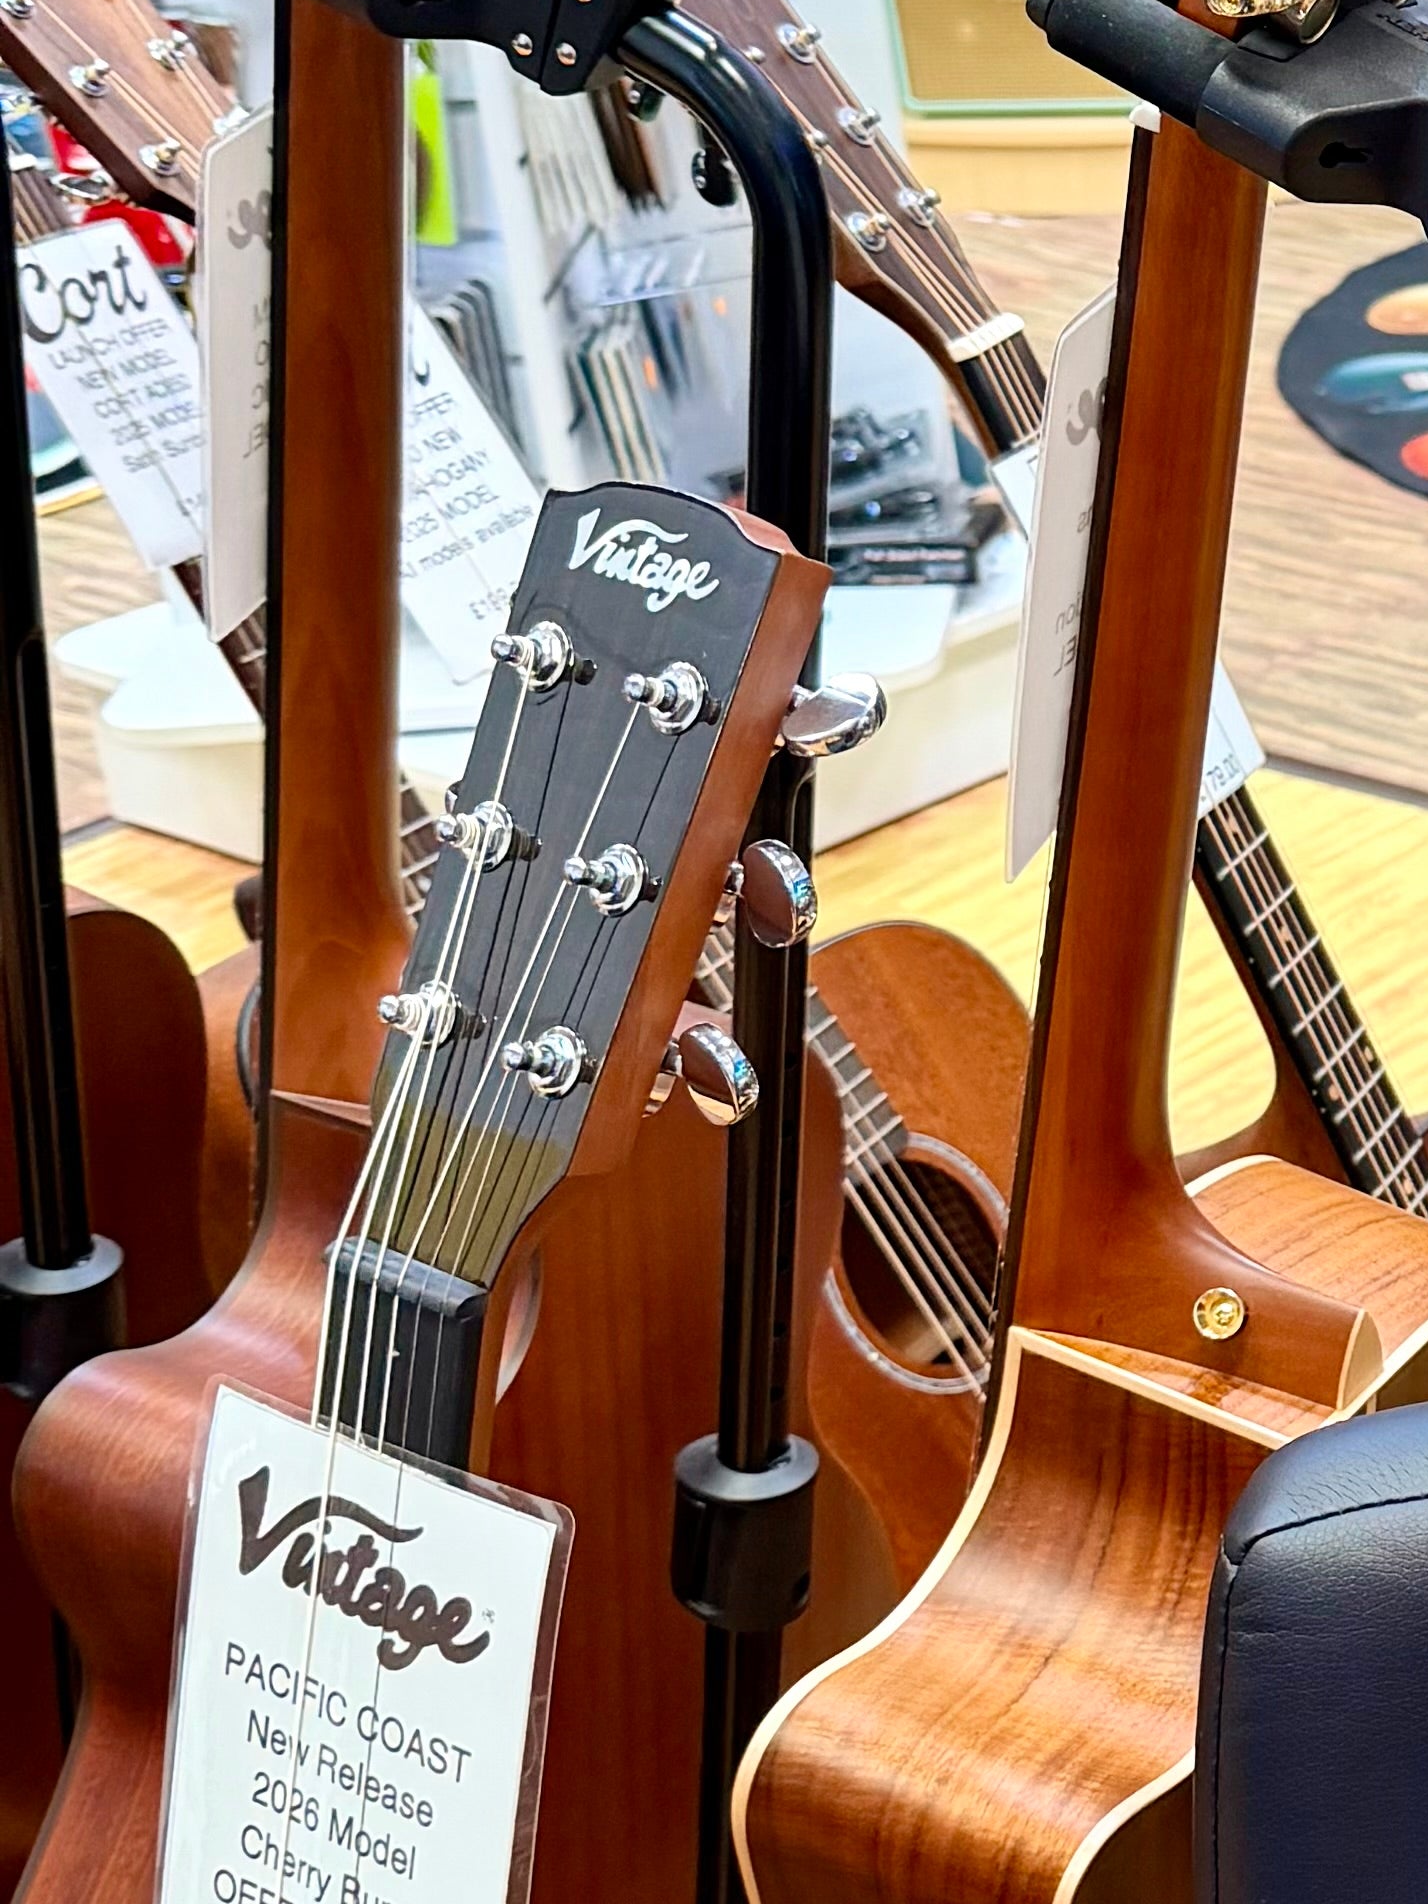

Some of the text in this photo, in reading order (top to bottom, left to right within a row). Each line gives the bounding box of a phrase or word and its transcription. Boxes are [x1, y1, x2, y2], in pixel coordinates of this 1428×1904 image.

[20, 244, 147, 344] Cort
[568, 507, 722, 614] Vintage
[235, 1465, 491, 1671] Vintage
[225, 1640, 472, 1784] PACIFIC COAST
[247, 1710, 435, 1831] New Release
[251, 1770, 417, 1884] 2026 Model
